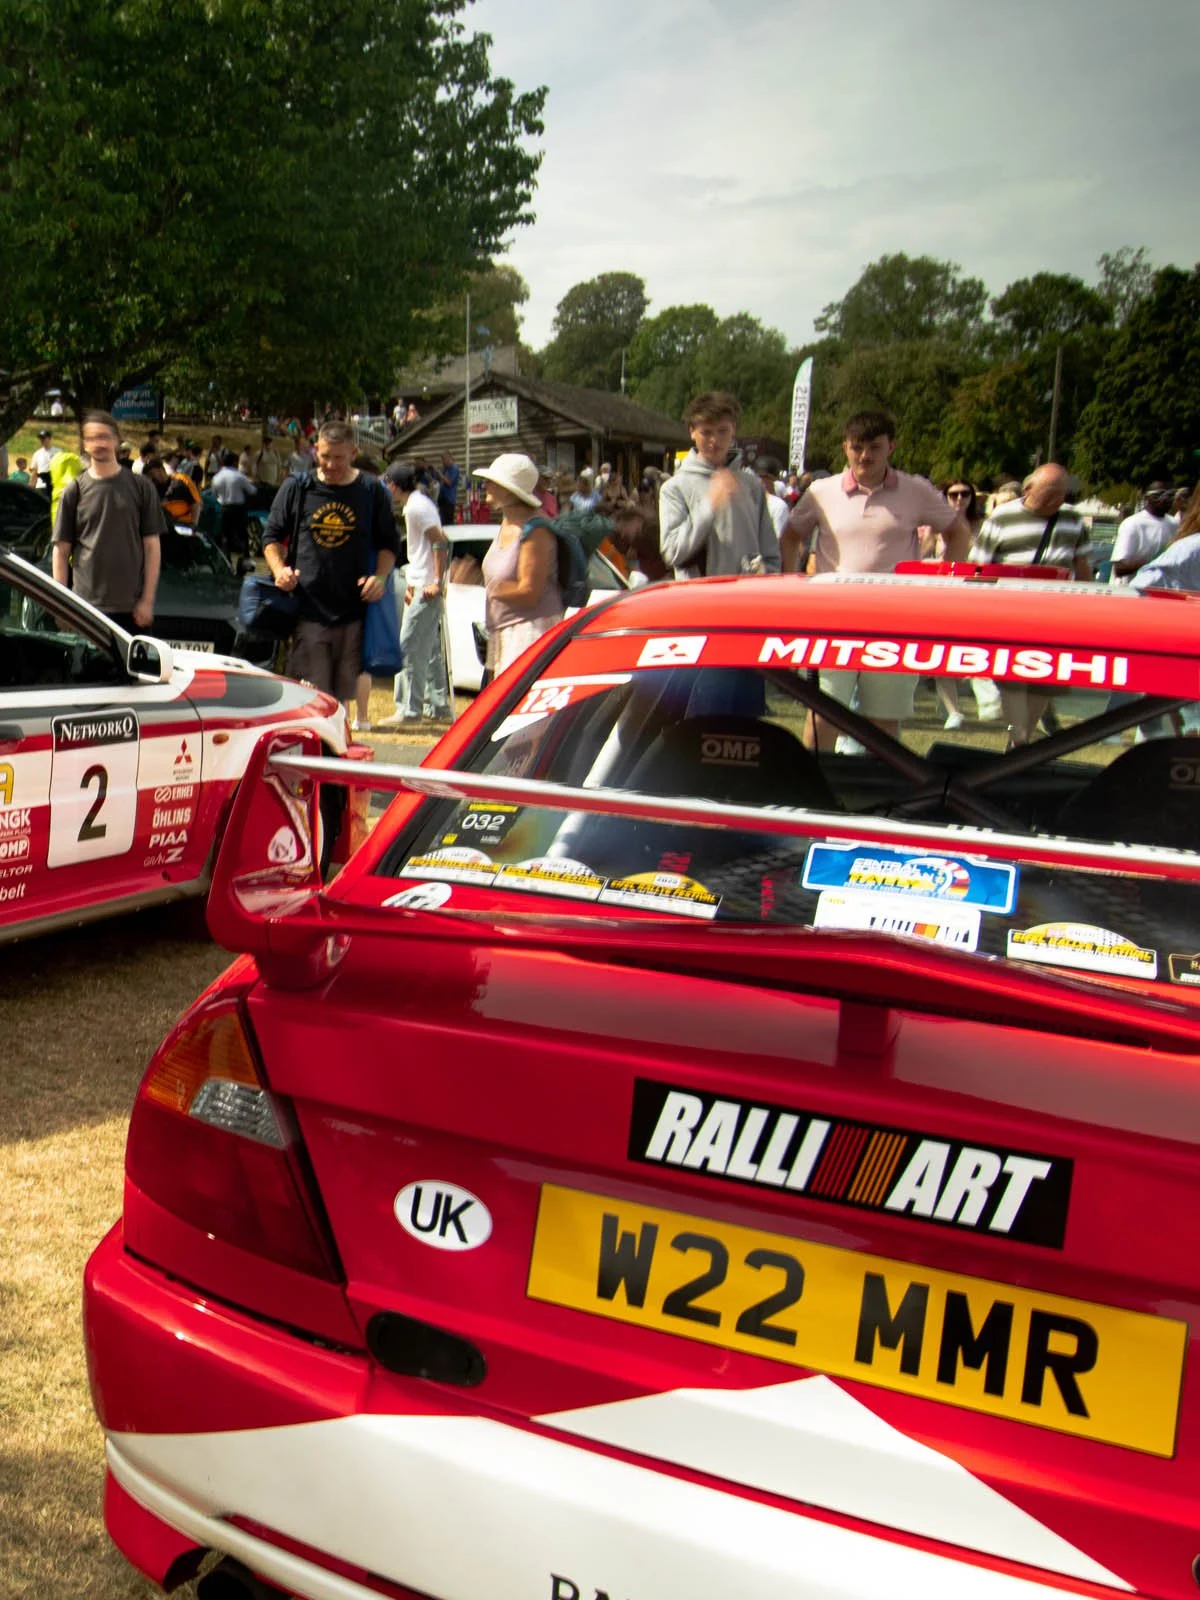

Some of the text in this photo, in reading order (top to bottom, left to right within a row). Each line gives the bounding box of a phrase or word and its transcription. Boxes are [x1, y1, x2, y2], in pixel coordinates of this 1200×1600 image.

[756, 636, 1129, 687] MITSUBISHI
[520, 685, 575, 713] 124
[701, 739, 761, 761] OMP
[77, 763, 109, 843] 2
[152, 807, 192, 829] ÖHLINS
[460, 813, 507, 832] 032
[0, 841, 29, 859] OMP
[148, 829, 188, 849] PIAA
[848, 873, 921, 890] RALLY
[410, 1186, 469, 1245] UK
[596, 1212, 1100, 1420] W22 MMR
